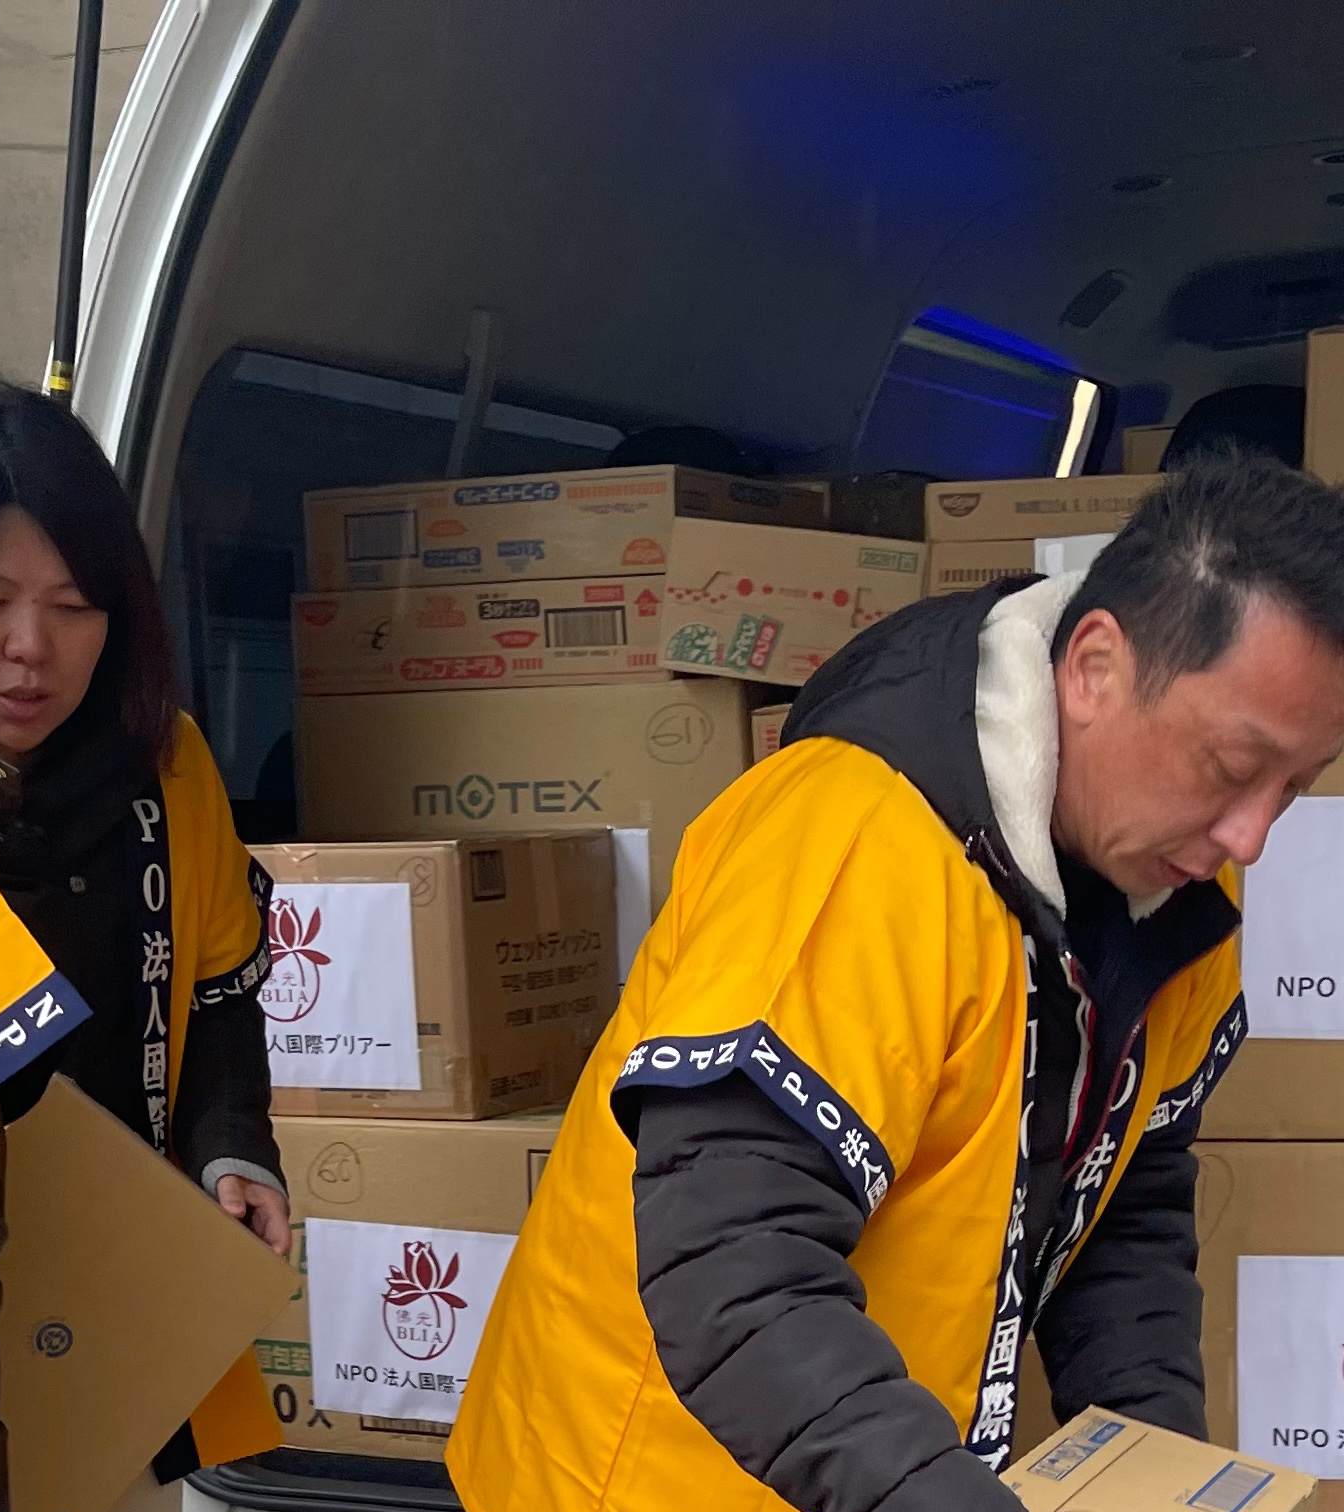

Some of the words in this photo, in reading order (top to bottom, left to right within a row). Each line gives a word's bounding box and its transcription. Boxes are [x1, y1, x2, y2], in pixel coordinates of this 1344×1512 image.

[261, 988, 309, 1004] BLIA
[1276, 976, 1336, 998] NPO
[396, 1326, 443, 1344] BLIA
[335, 1363, 378, 1383] NPO
[1272, 1427, 1330, 1449] NPO
